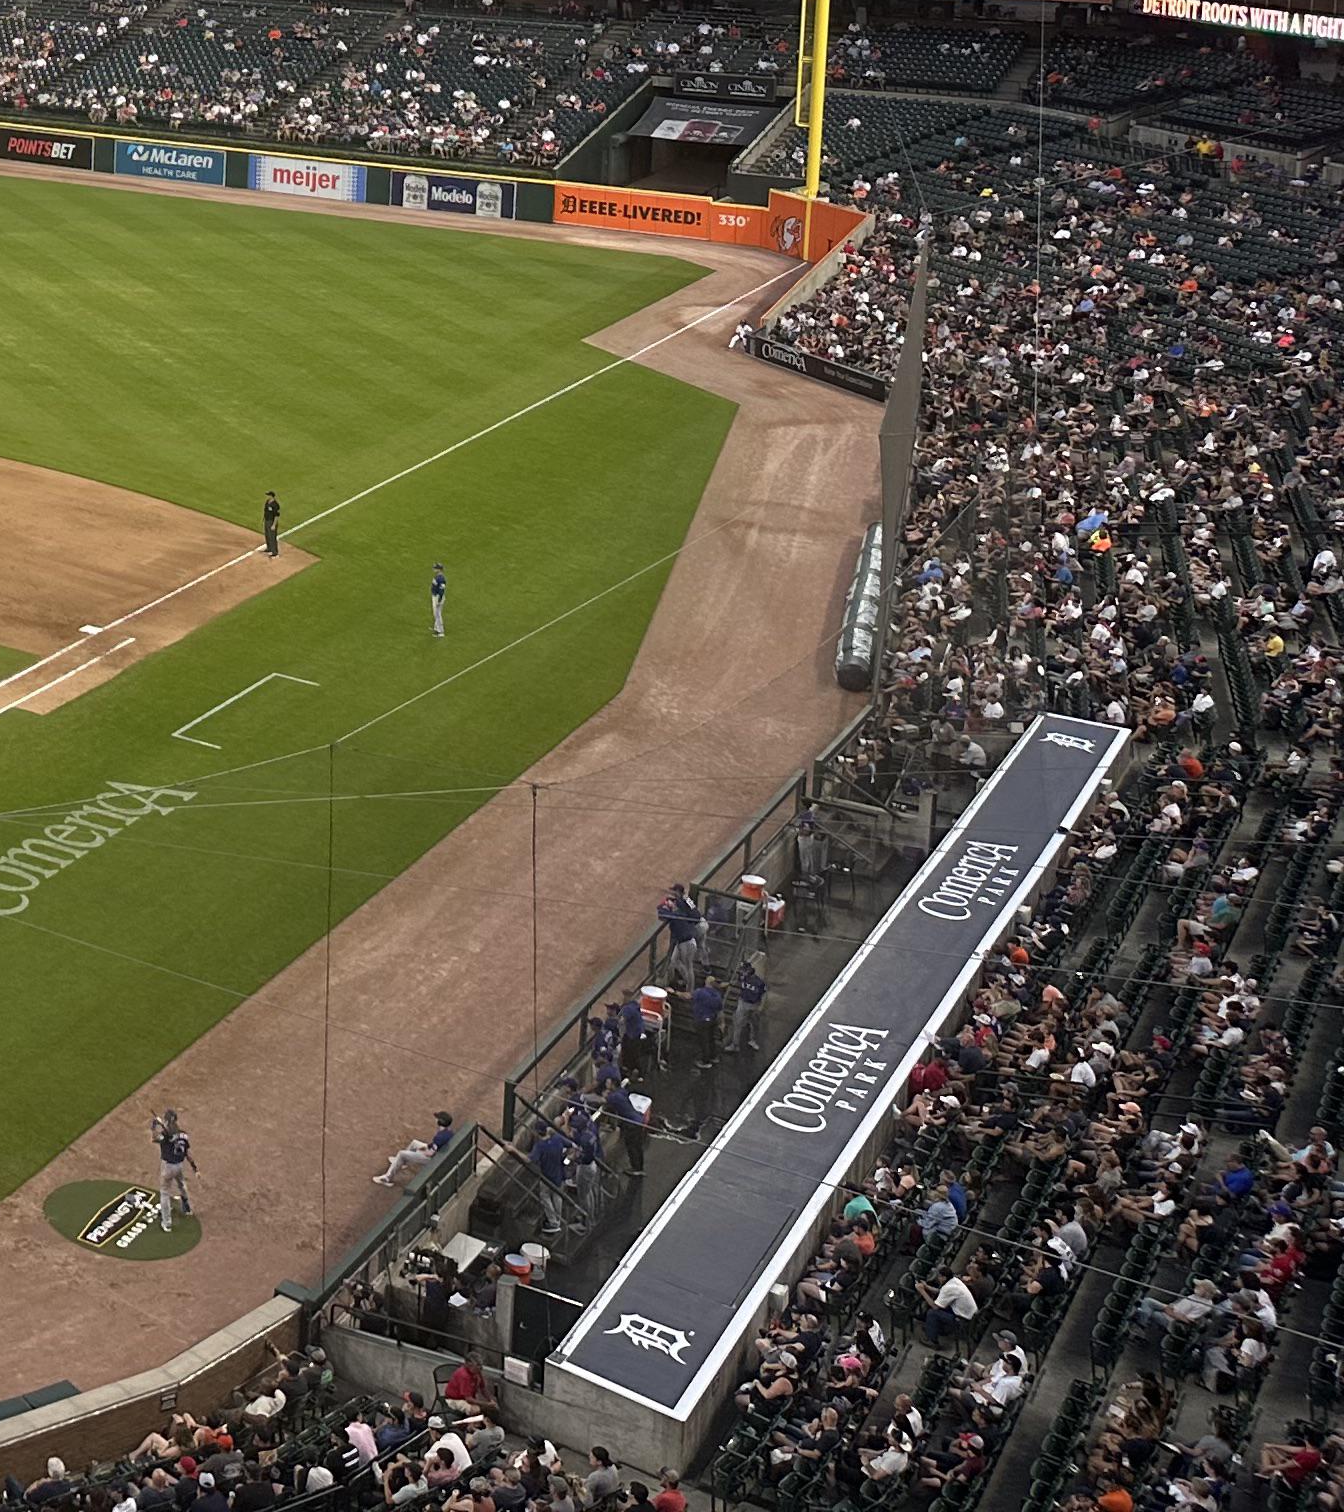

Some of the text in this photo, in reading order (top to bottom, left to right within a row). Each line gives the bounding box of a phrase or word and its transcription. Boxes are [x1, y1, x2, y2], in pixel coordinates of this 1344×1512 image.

[1202, 1, 1248, 27] ROOTS
[1250, 7, 1288, 34] WITH
[1289, 15, 1301, 34] A
[8, 138, 76, 160] POINTSBET
[150, 148, 212, 169] McLaren
[142, 166, 197, 179] HEALTH CARE
[273, 166, 340, 192] meijer
[431, 186, 473, 204] Modelo
[561, 193, 701, 225] DEEEE-LIVERED!
[719, 213, 750, 227] 330'
[918, 839, 1019, 922] Comerica
[977, 860, 1020, 907] PARK
[765, 1023, 889, 1133] Comerica
[835, 1059, 888, 1113] PARK
[116, 1222, 147, 1248] GRASS
